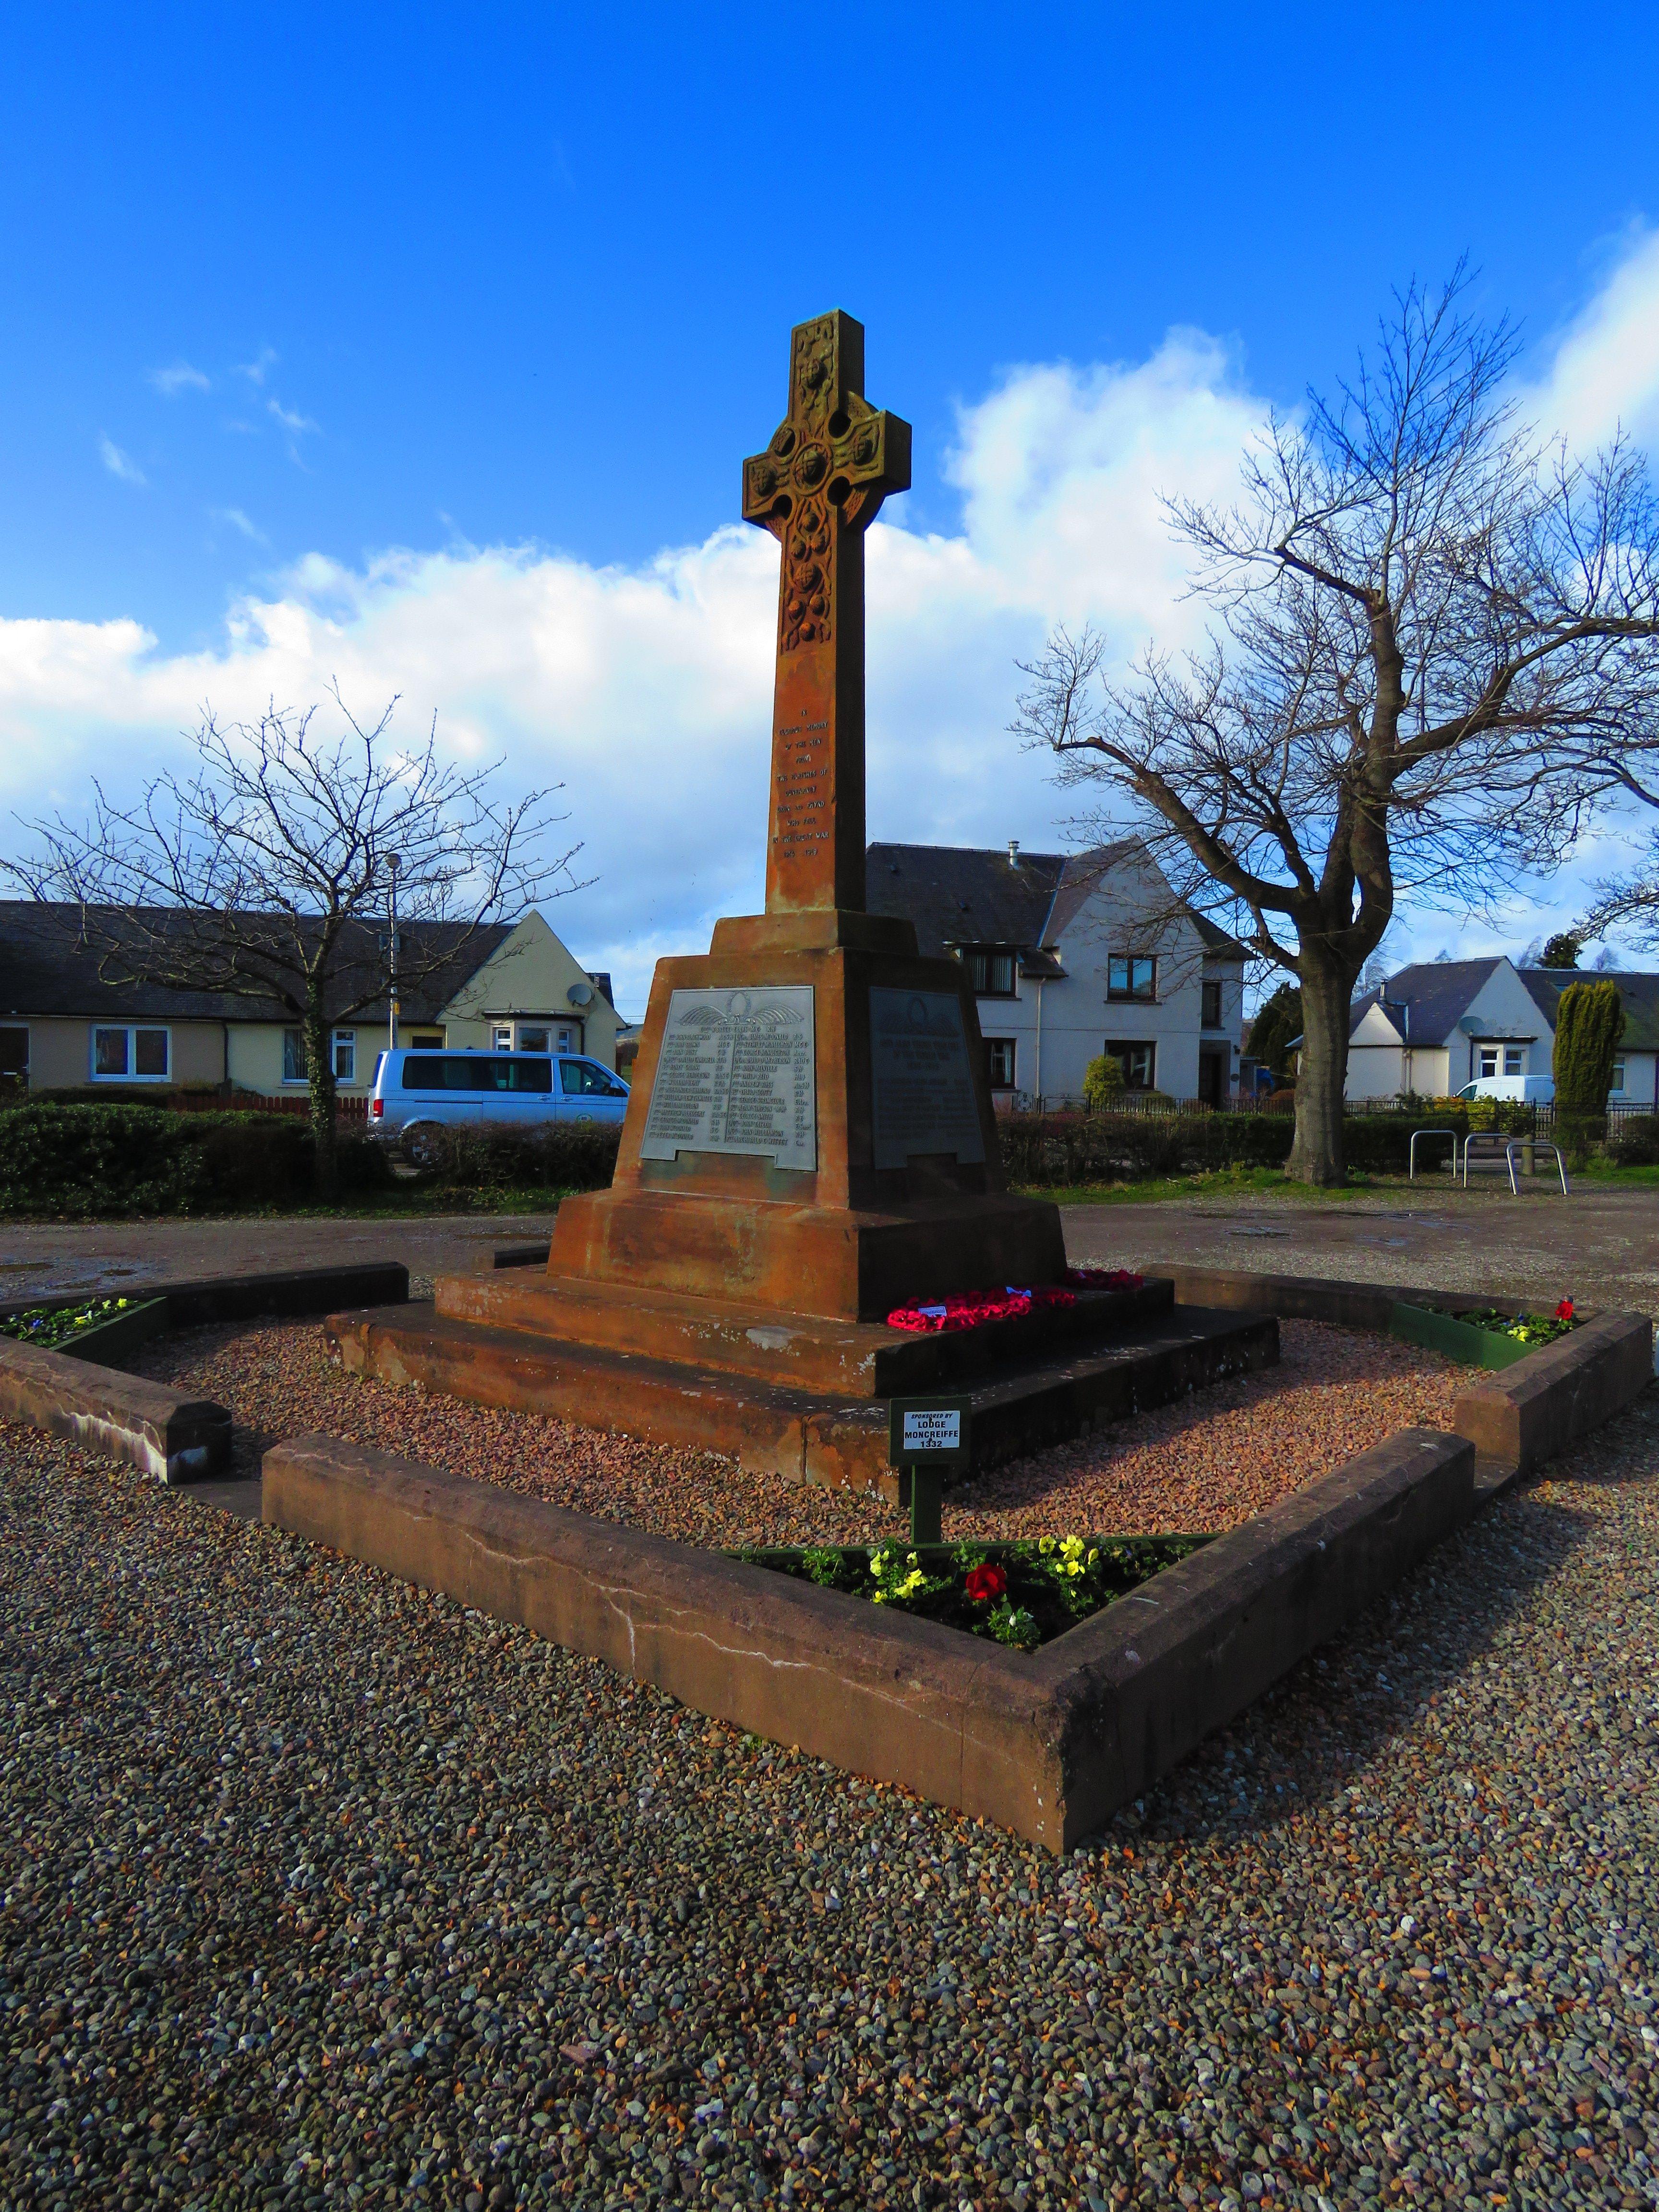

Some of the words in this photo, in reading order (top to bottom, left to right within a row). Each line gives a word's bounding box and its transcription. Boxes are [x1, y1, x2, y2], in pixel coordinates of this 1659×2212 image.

[807, 721, 828, 731] MEMORY
[810, 738, 821, 746] MEN
[796, 754, 811, 764] FROM
[795, 833, 812, 842] GREAT
[905, 1430, 958, 1439] MONCREIFFE
